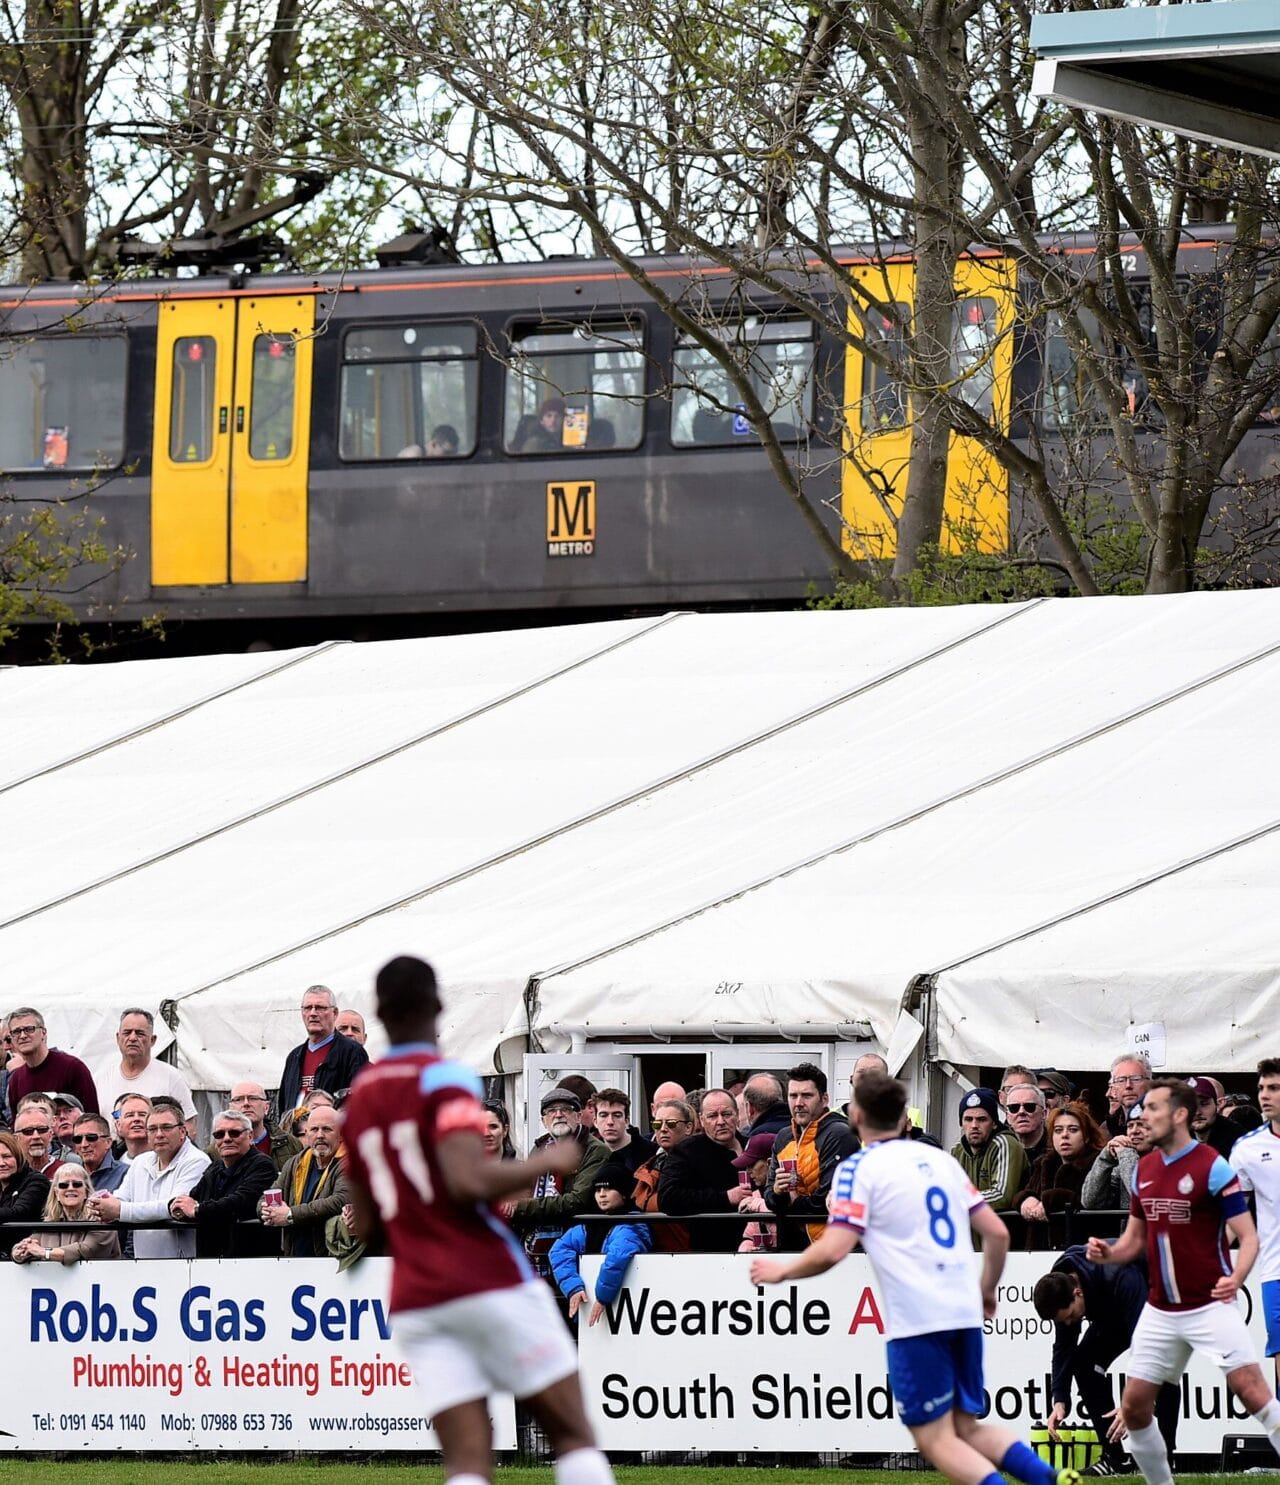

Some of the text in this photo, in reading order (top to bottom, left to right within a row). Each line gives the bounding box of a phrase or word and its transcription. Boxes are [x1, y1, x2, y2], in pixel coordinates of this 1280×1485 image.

[551, 486, 592, 537] M
[548, 541, 594, 556] METRO
[715, 981, 744, 994] EXIT
[1134, 1033, 1150, 1044] CAN
[357, 1120, 435, 1223] 11
[926, 1186, 956, 1249] 8
[31, 1284, 158, 1343] Rob.S
[180, 1286, 266, 1343] Gas
[604, 1285, 831, 1336] Wearside
[74, 1353, 412, 1397] Plumbing & Heating Engine
[602, 1373, 735, 1420] South
[751, 1372, 894, 1421] Shield
[32, 1413, 55, 1431] Tel:
[60, 1413, 86, 1431] 0191
[91, 1413, 114, 1431] 454
[120, 1413, 146, 1431] 1140
[161, 1412, 196, 1431] Mob:
[201, 1413, 238, 1431] 07988
[244, 1413, 266, 1431] 653
[271, 1413, 293, 1431] 736
